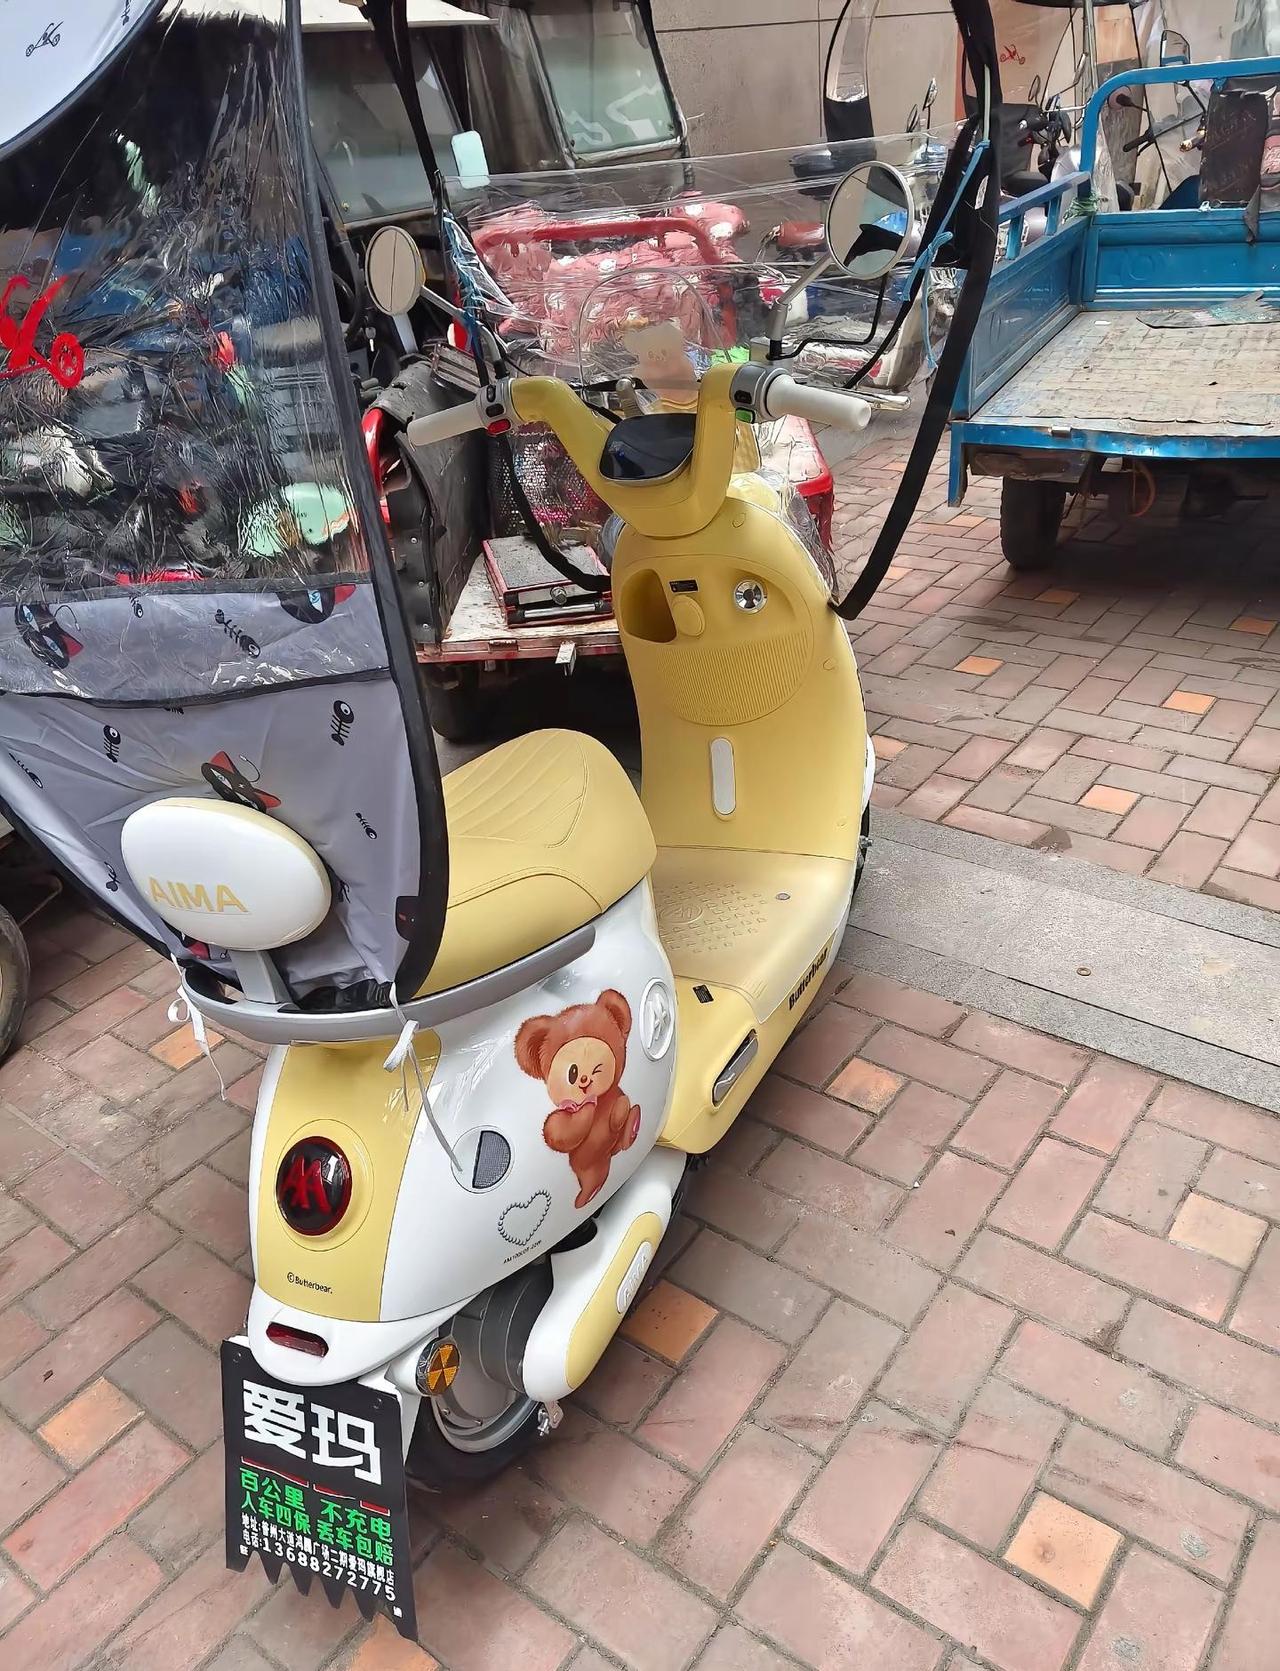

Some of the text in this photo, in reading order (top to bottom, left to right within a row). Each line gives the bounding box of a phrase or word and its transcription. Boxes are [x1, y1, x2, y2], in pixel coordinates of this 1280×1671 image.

[149, 876, 249, 913] AIMA
[242, 1379, 382, 1485] 爱玛
[239, 1467, 393, 1543] 百公里 不充电
[240, 1490, 393, 1566] 人车四保 丢车包赔
